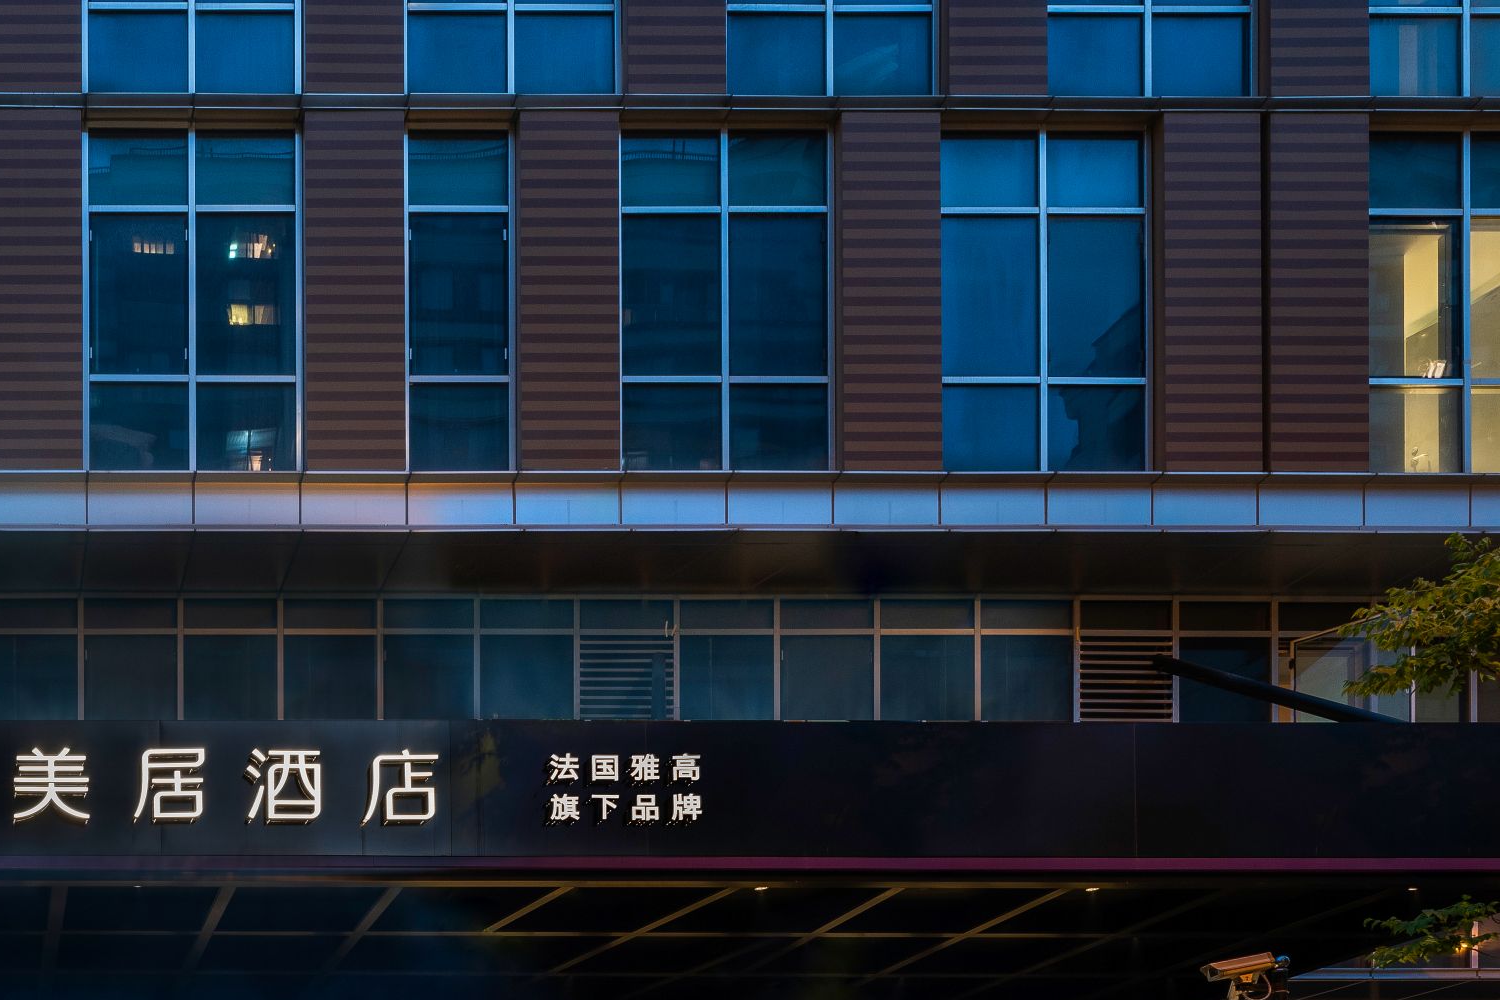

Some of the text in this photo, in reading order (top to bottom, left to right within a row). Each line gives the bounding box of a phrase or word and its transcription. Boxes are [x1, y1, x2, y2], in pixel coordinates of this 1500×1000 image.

[550, 752, 701, 782] 法国雅高
[12, 746, 440, 824] 美居酒店
[550, 792, 703, 821] 旗下品牌
